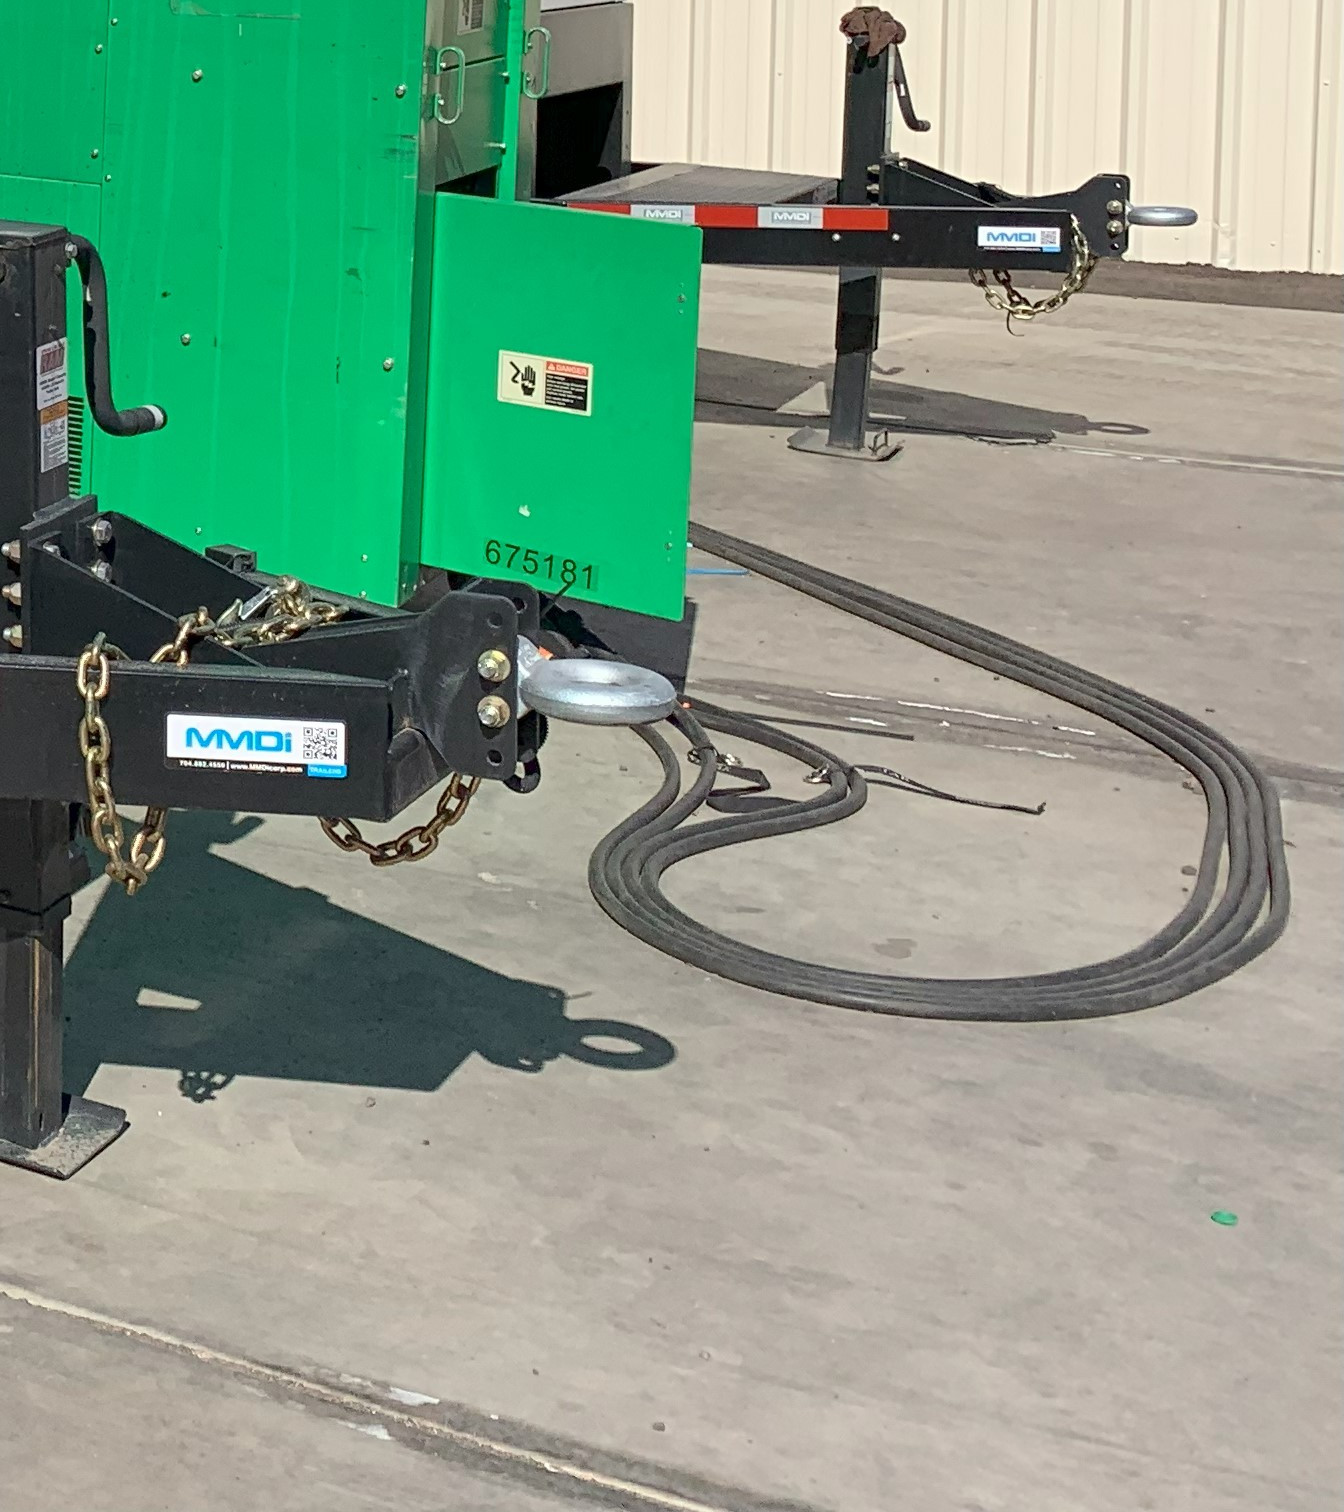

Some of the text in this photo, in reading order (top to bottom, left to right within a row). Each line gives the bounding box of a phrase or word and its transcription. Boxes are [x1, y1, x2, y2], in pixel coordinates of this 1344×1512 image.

[555, 364, 587, 376] DANGER
[485, 539, 593, 589] 675181
[185, 727, 292, 752] MMDi
